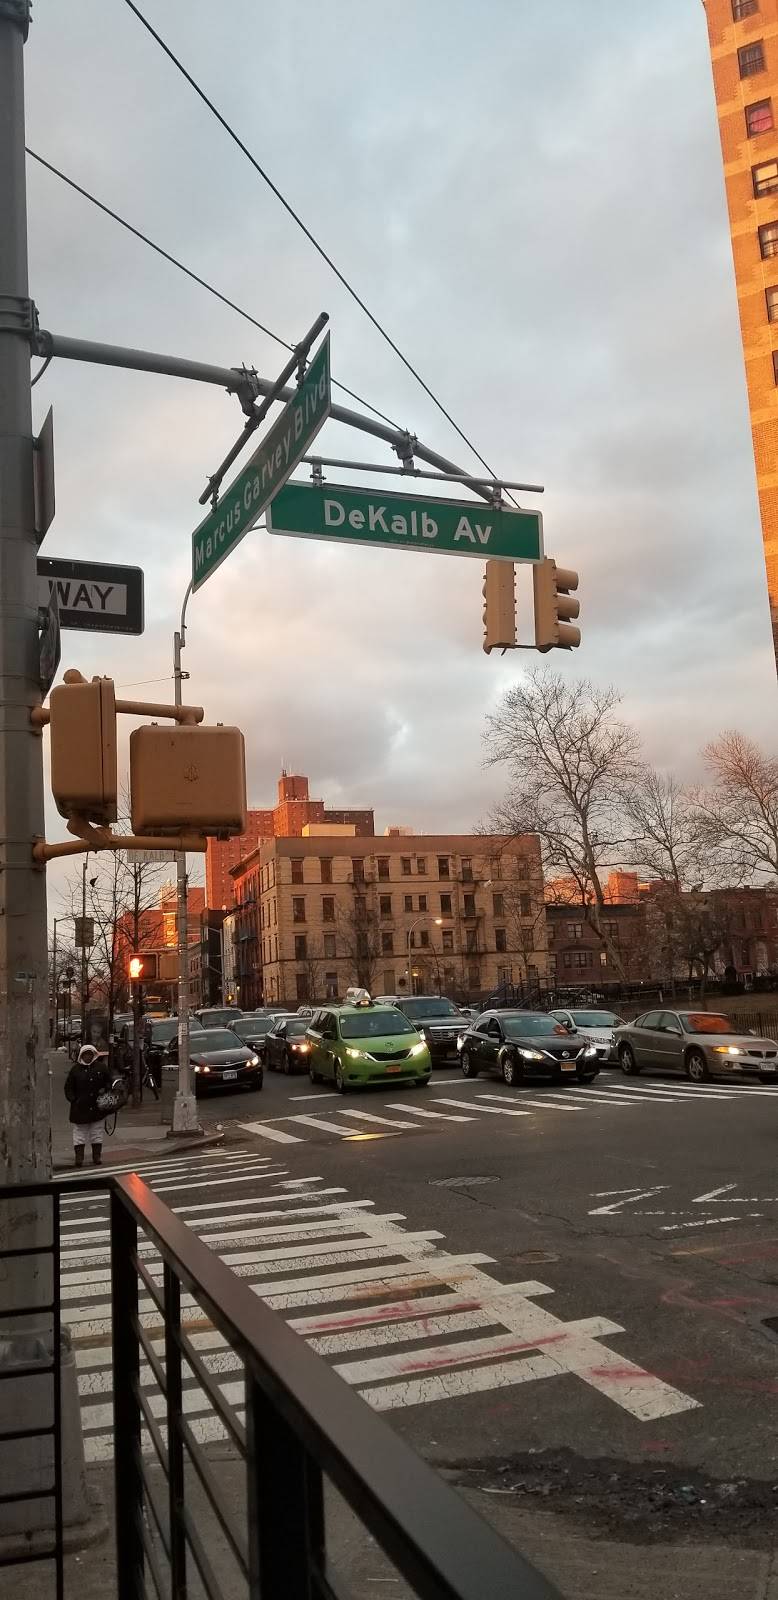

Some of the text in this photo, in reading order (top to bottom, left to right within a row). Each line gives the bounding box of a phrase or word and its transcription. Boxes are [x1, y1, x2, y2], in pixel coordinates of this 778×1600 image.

[194, 362, 326, 571] Marcus Garvey Blvd
[324, 499, 493, 545] DeKalb Av
[48, 579, 115, 611] WAY
